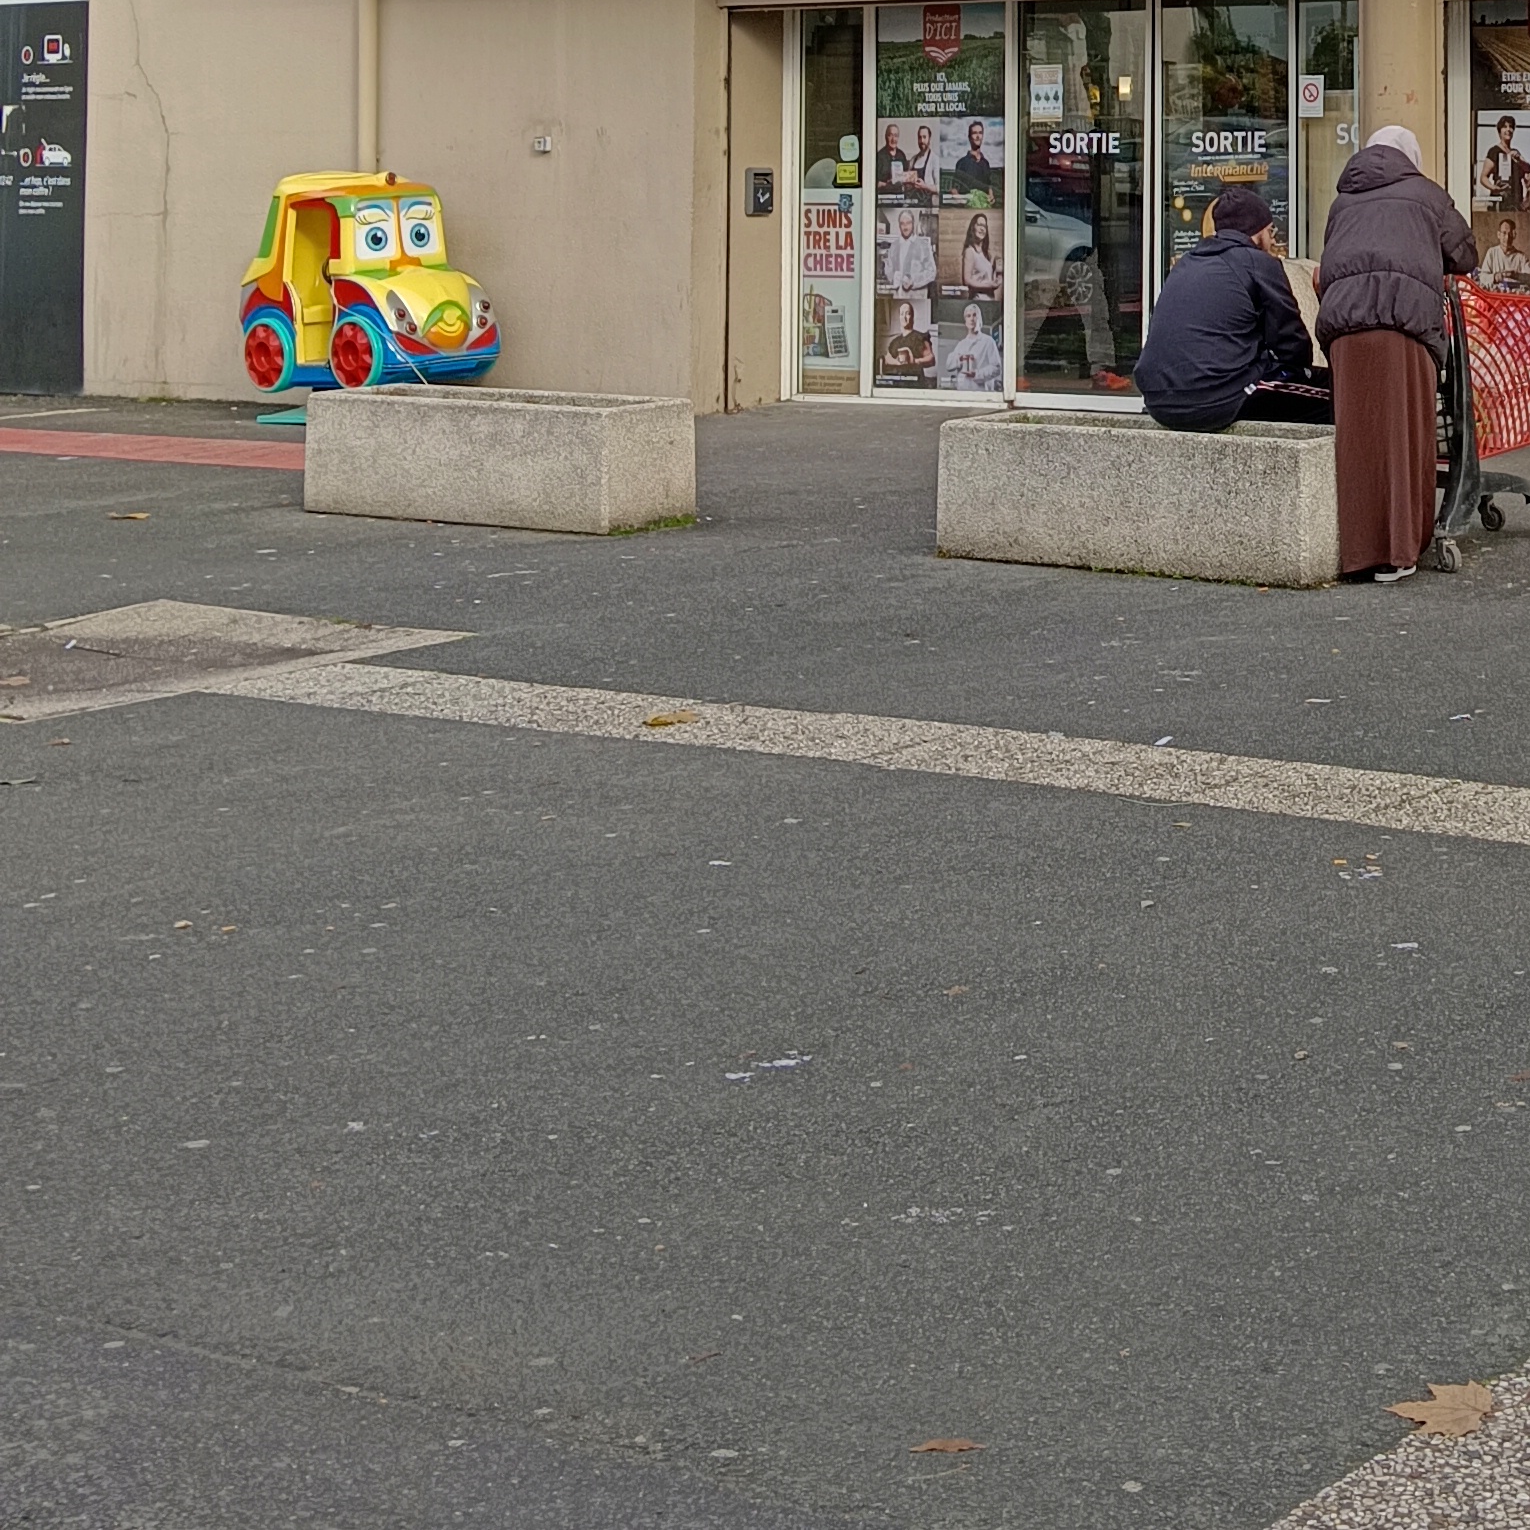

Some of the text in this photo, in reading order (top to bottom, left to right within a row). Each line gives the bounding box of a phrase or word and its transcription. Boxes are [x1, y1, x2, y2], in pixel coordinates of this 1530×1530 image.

[925, 22, 958, 40] D'ICI
[1501, 83, 1524, 93] POUR
[1048, 131, 1121, 155] SORTIE
[1191, 131, 1267, 153] SORTIE
[803, 230, 854, 251] TRE LA
